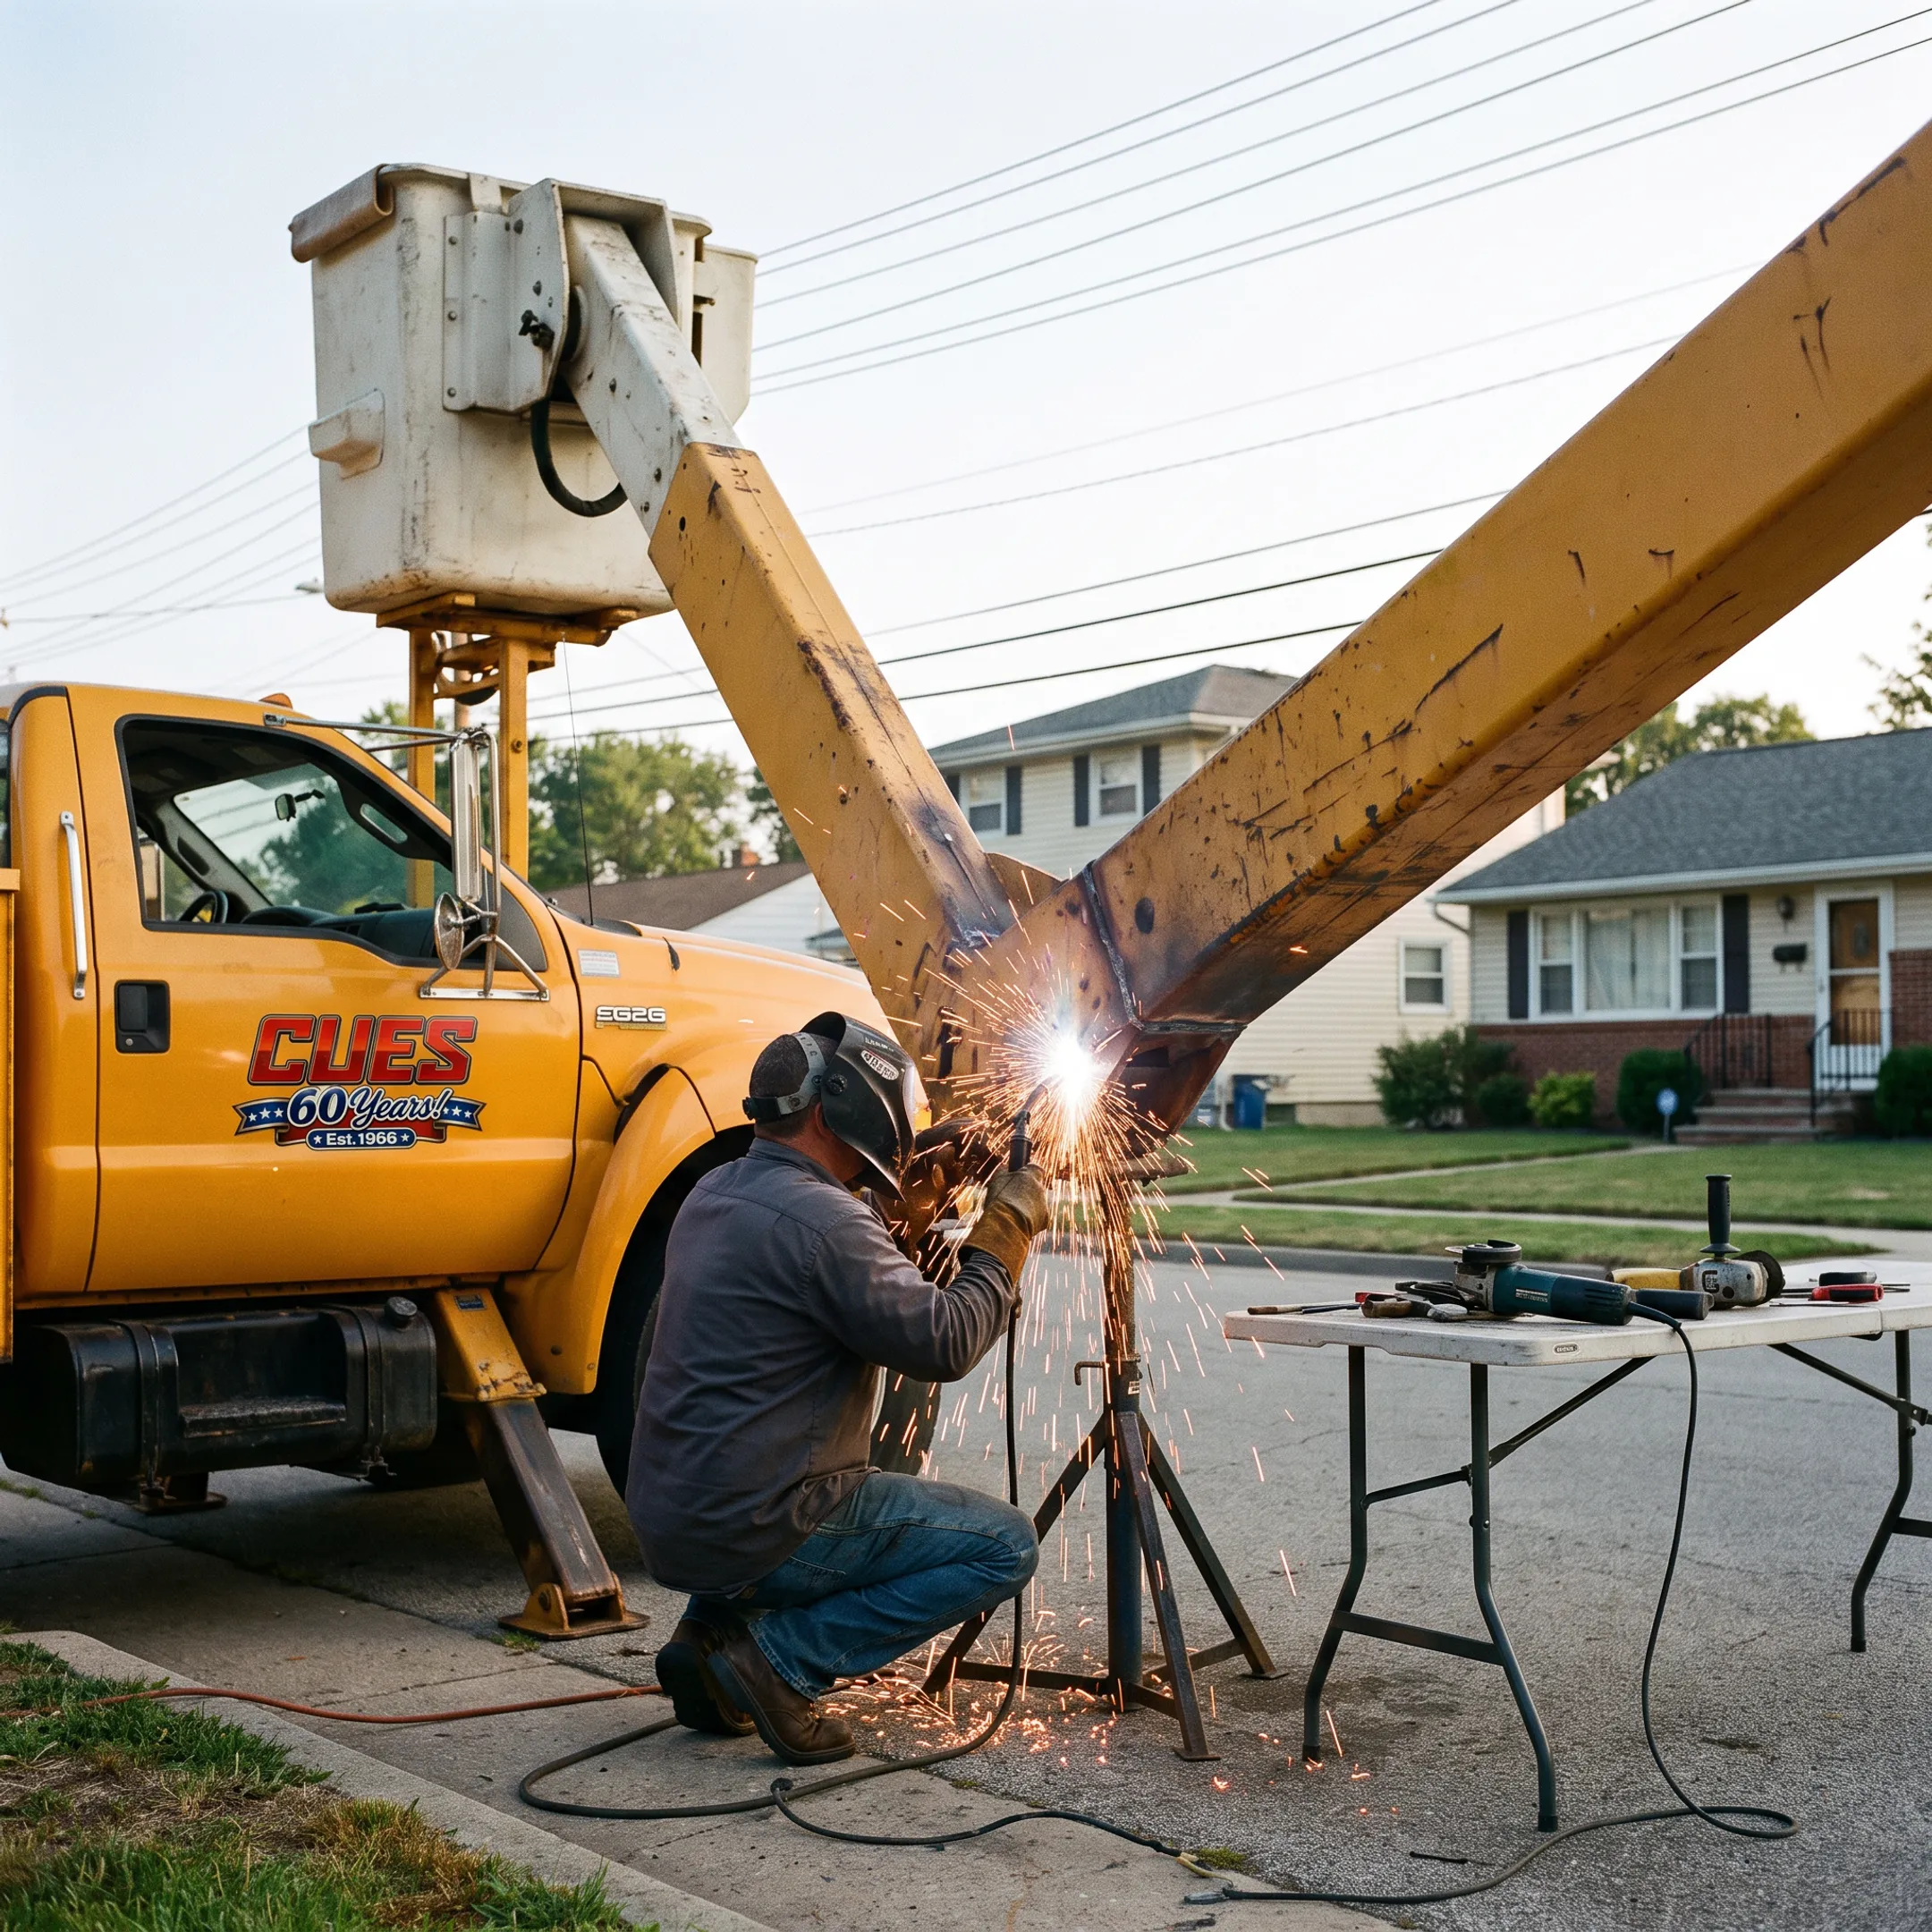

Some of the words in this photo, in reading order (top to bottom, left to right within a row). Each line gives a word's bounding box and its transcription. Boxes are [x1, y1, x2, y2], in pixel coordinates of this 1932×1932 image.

[247, 1014, 478, 1085] CUES
[287, 1085, 349, 1127] 60
[348, 1085, 453, 1131] Years!
[326, 1131, 356, 1146] Est.
[358, 1131, 398, 1146] 1966
